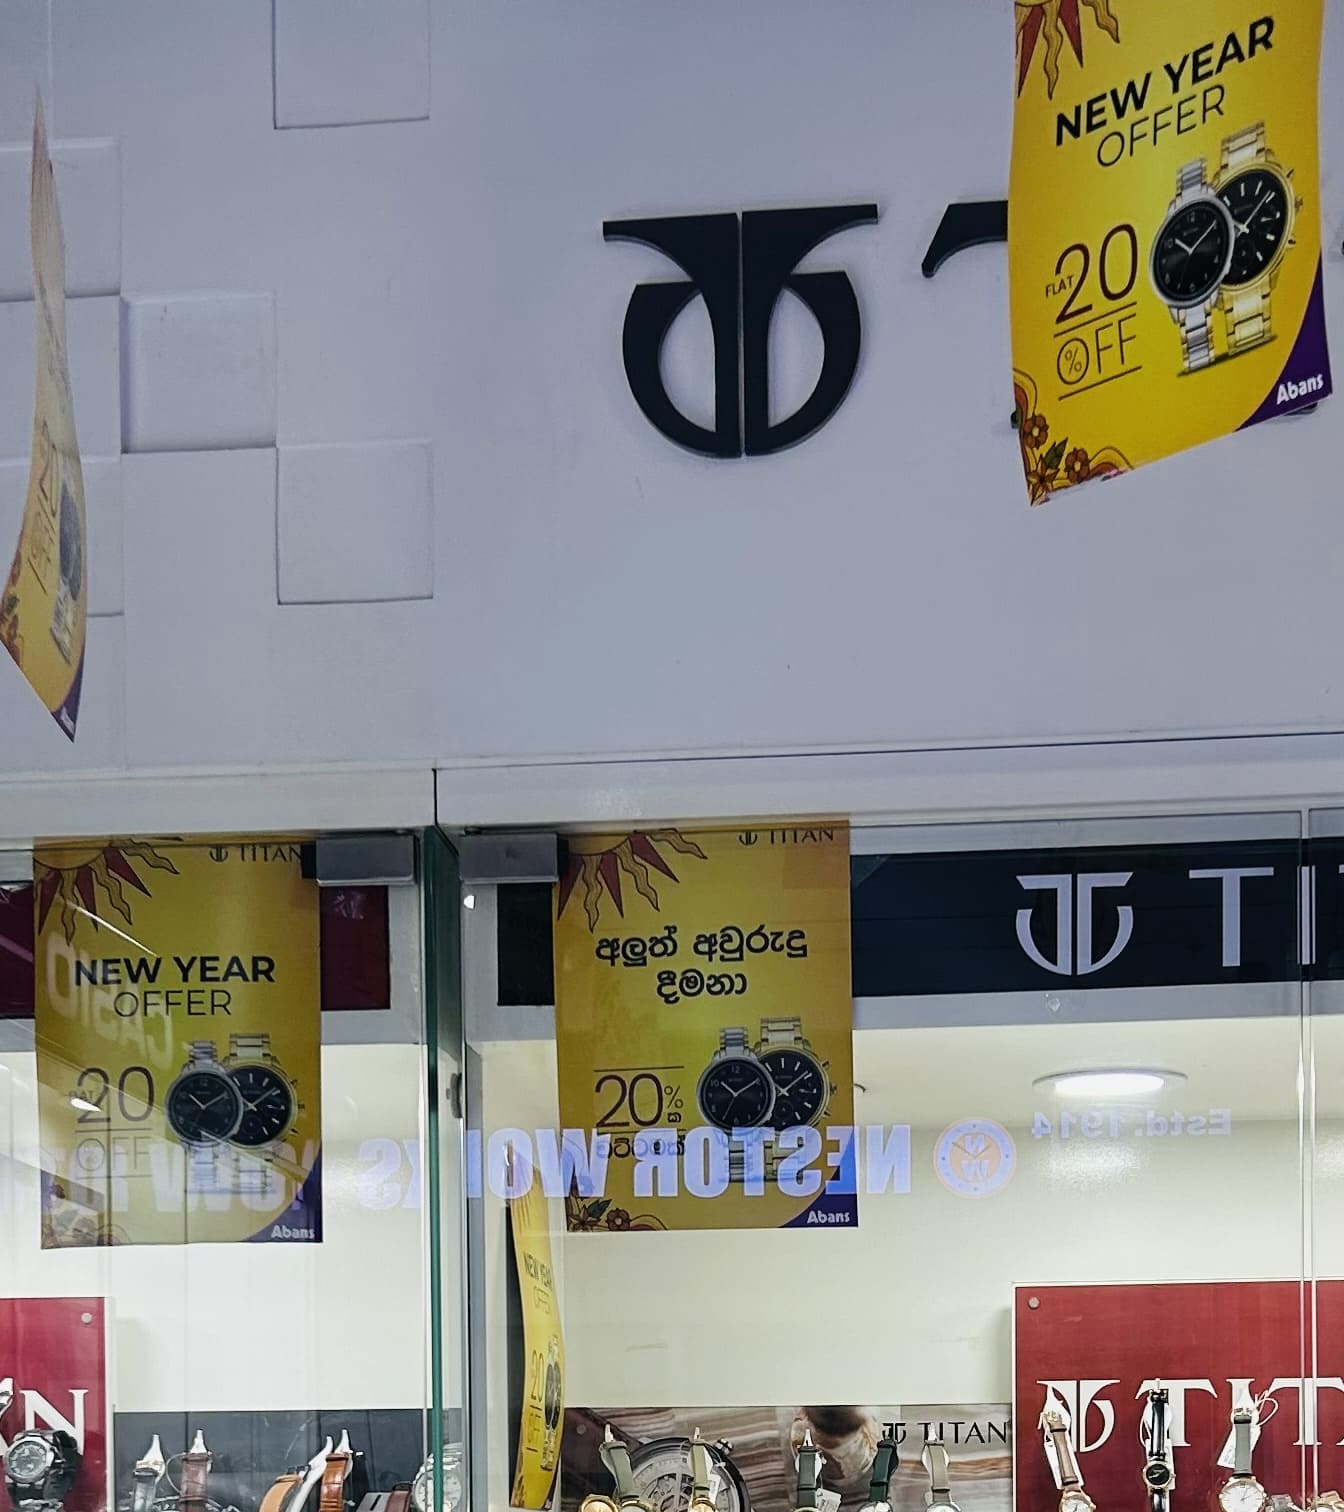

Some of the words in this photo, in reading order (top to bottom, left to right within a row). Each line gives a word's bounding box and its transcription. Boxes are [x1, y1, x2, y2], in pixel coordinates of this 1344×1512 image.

[1054, 70, 1151, 147] NEW
[1163, 15, 1276, 95] YEAR
[1095, 86, 1226, 169] OFFER
[1045, 274, 1074, 299] FLAT
[1055, 223, 1140, 324] 20
[1056, 326, 1138, 387] OFF
[1275, 372, 1325, 406] Abans
[75, 956, 161, 986] NEW
[173, 955, 275, 984] YEAR
[113, 989, 233, 1017] OFFER
[76, 1066, 155, 1124] 20
[271, 1224, 315, 1240] Abans
[807, 1208, 851, 1225] Abans
[919, 1420, 1008, 1444] TITAN
